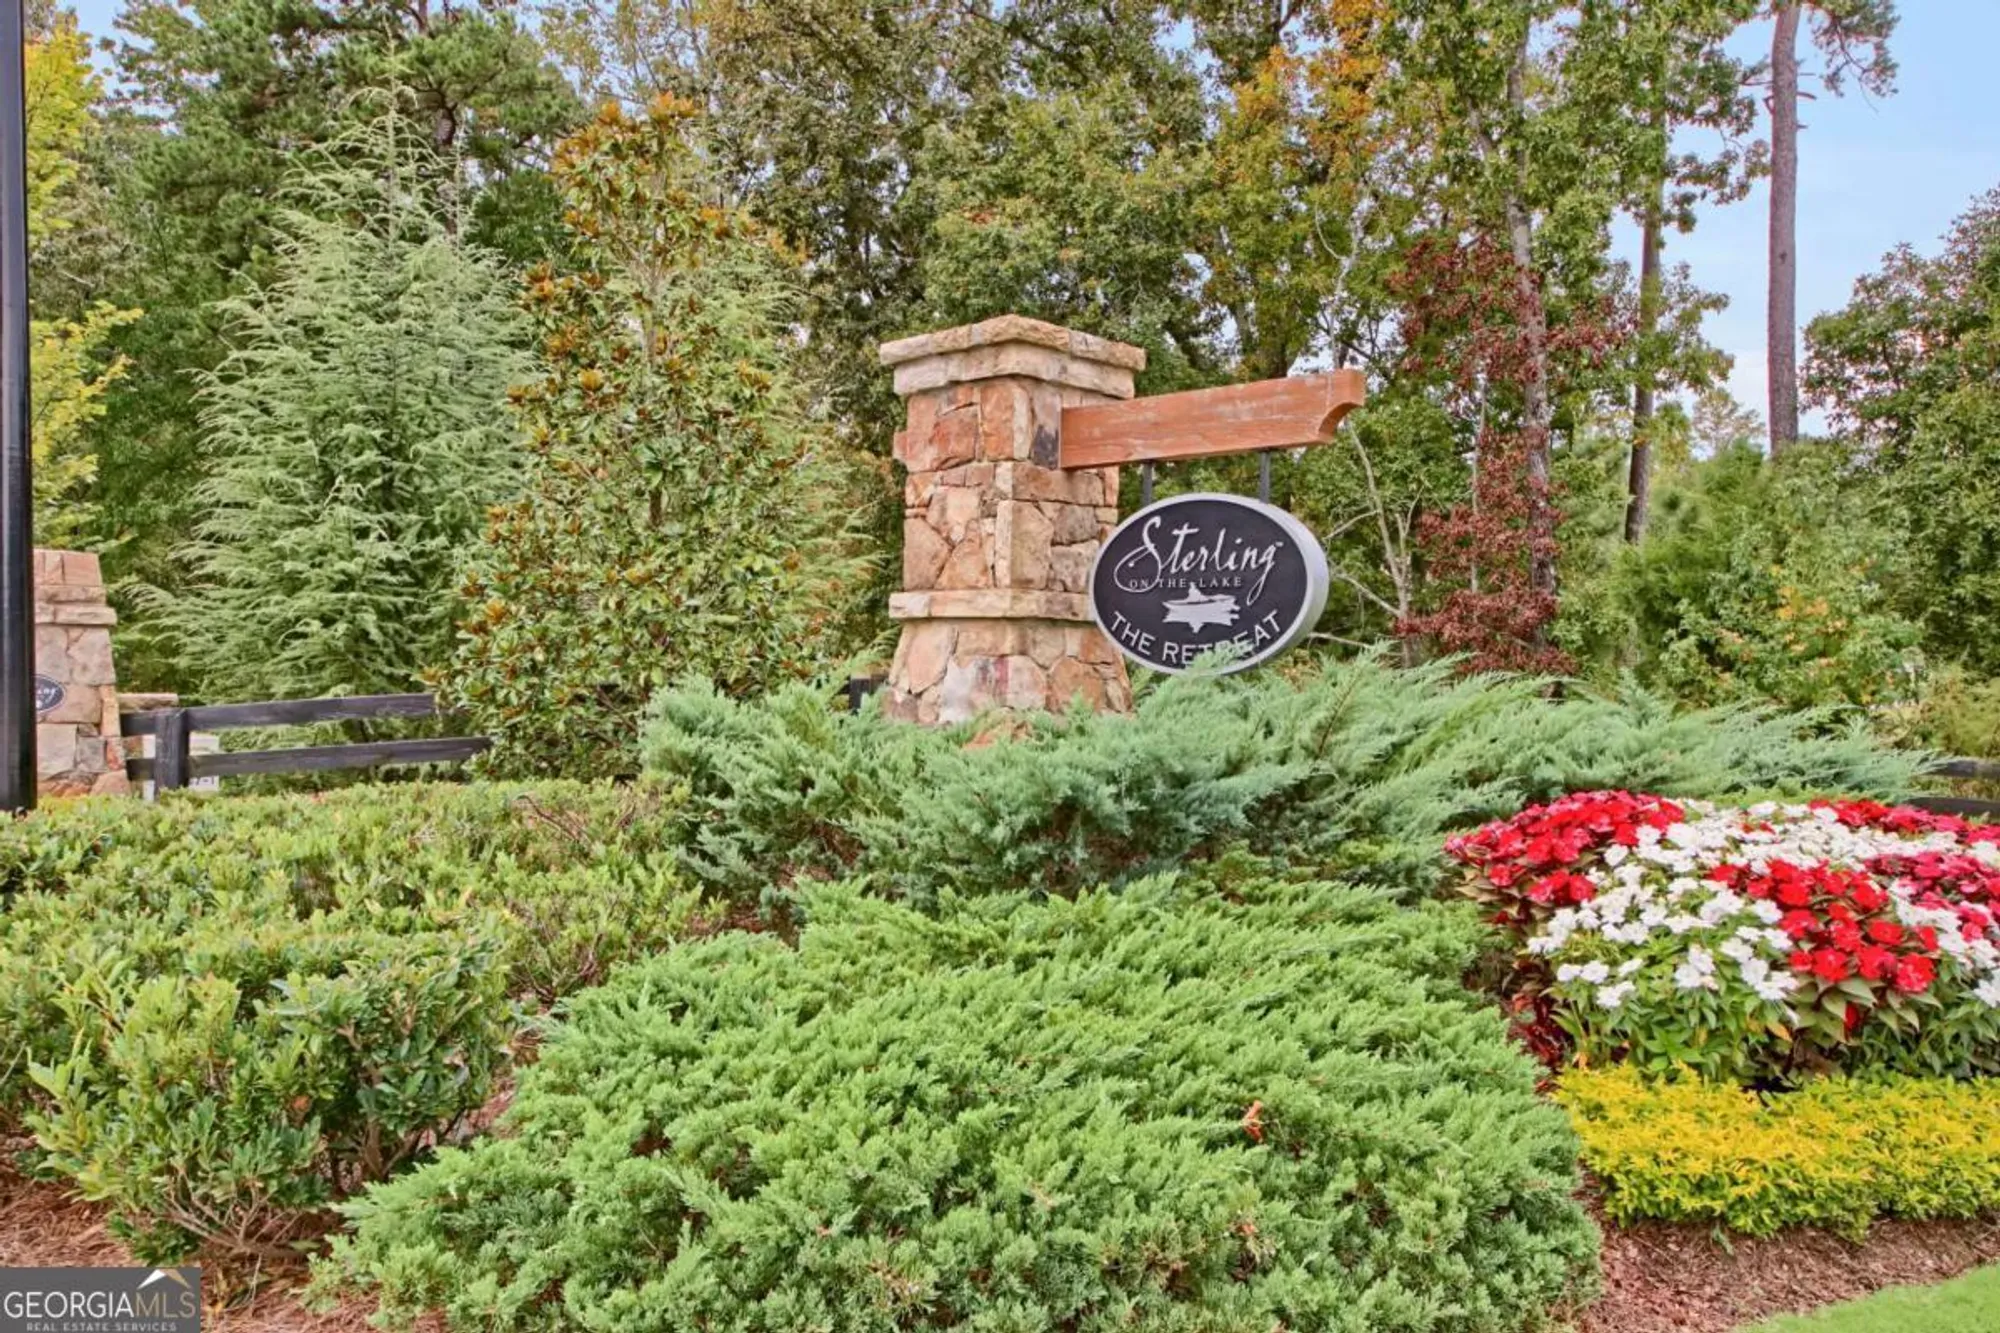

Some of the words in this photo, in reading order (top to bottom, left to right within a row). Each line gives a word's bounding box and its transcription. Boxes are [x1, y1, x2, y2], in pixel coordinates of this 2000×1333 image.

[1113, 515, 1278, 606] Sterling
[1129, 579, 1149, 590] ON
[1158, 578, 1187, 588] THE
[1199, 576, 1242, 588] LAKE
[1110, 610, 1156, 656] THE
